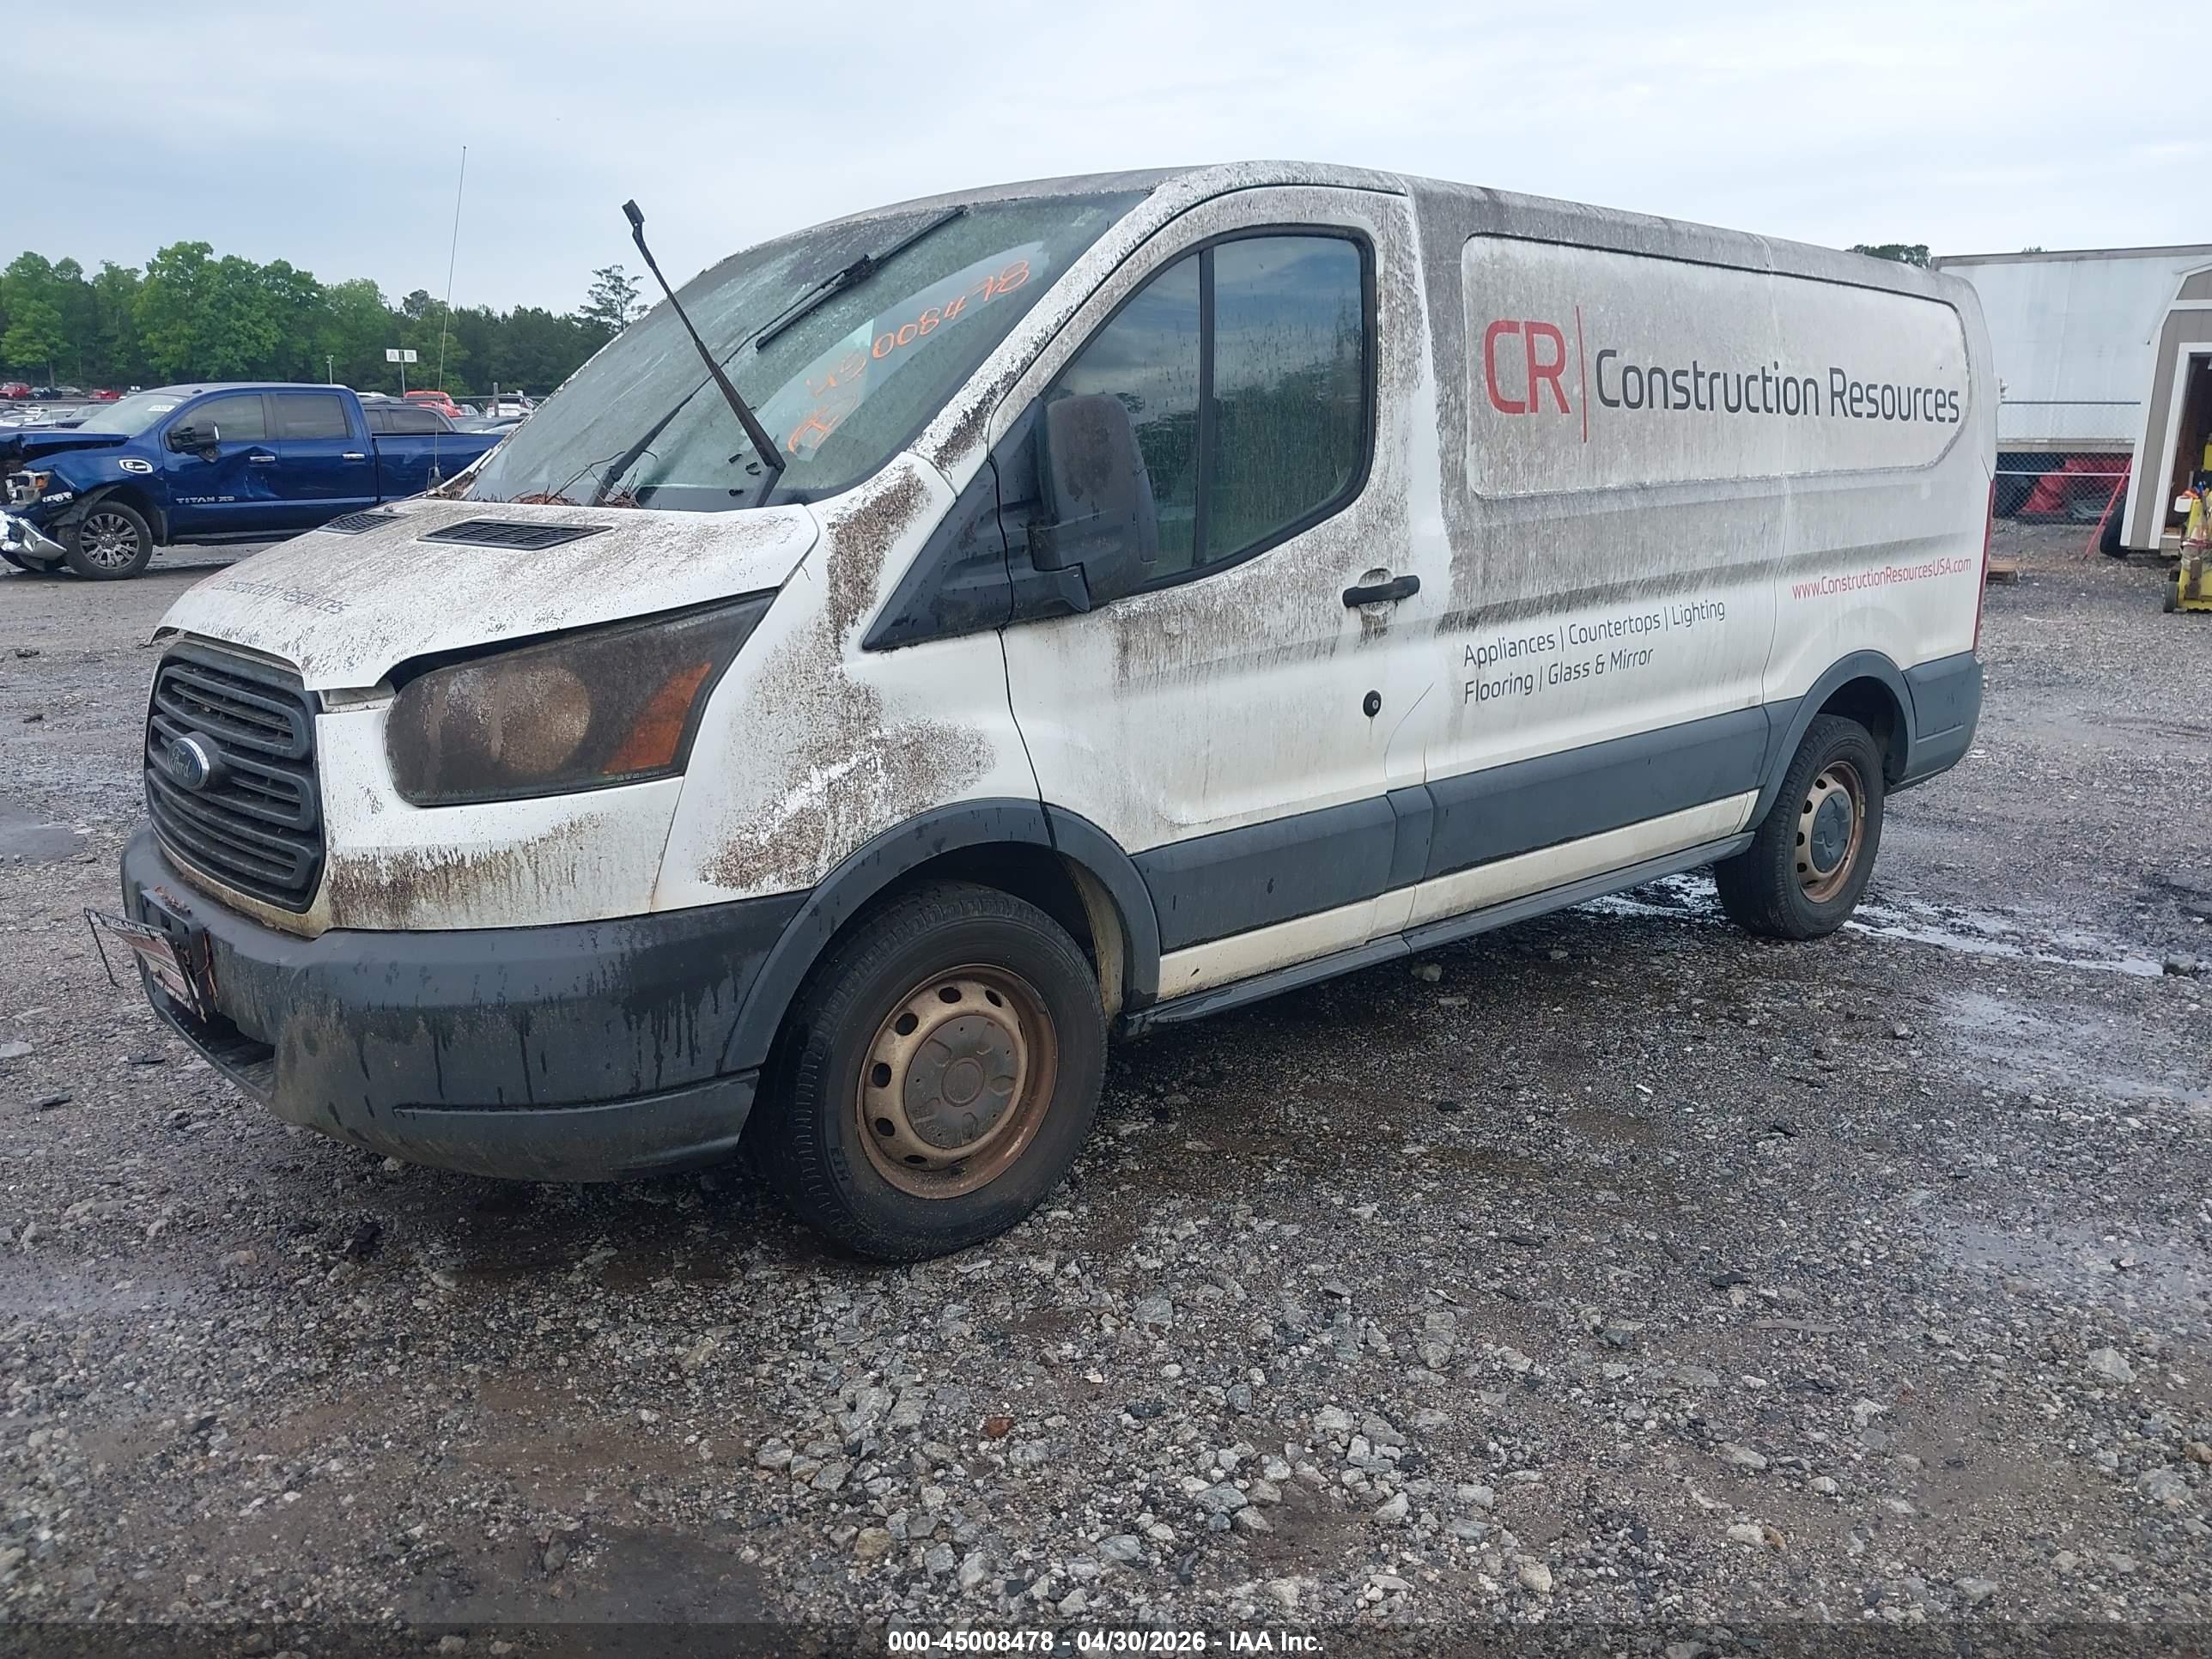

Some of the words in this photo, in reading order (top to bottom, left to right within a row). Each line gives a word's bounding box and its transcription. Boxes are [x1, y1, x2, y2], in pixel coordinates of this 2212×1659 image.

[1485, 320, 1571, 414] CR
[1596, 349, 1820, 416] Construction
[1829, 367, 1960, 423] Resources
[1792, 557, 1972, 599] www.ConstructionResourcesUSA.com
[1463, 632, 1555, 668] Appliances
[1568, 611, 1662, 645] Countertops
[1672, 599, 1726, 628] Lighting
[1464, 672, 1534, 705] Flooring
[1548, 661, 1590, 684] Glass
[1595, 653, 1606, 674] &
[1609, 647, 1655, 672] Mirror
[171, 745, 191, 778] Ford
